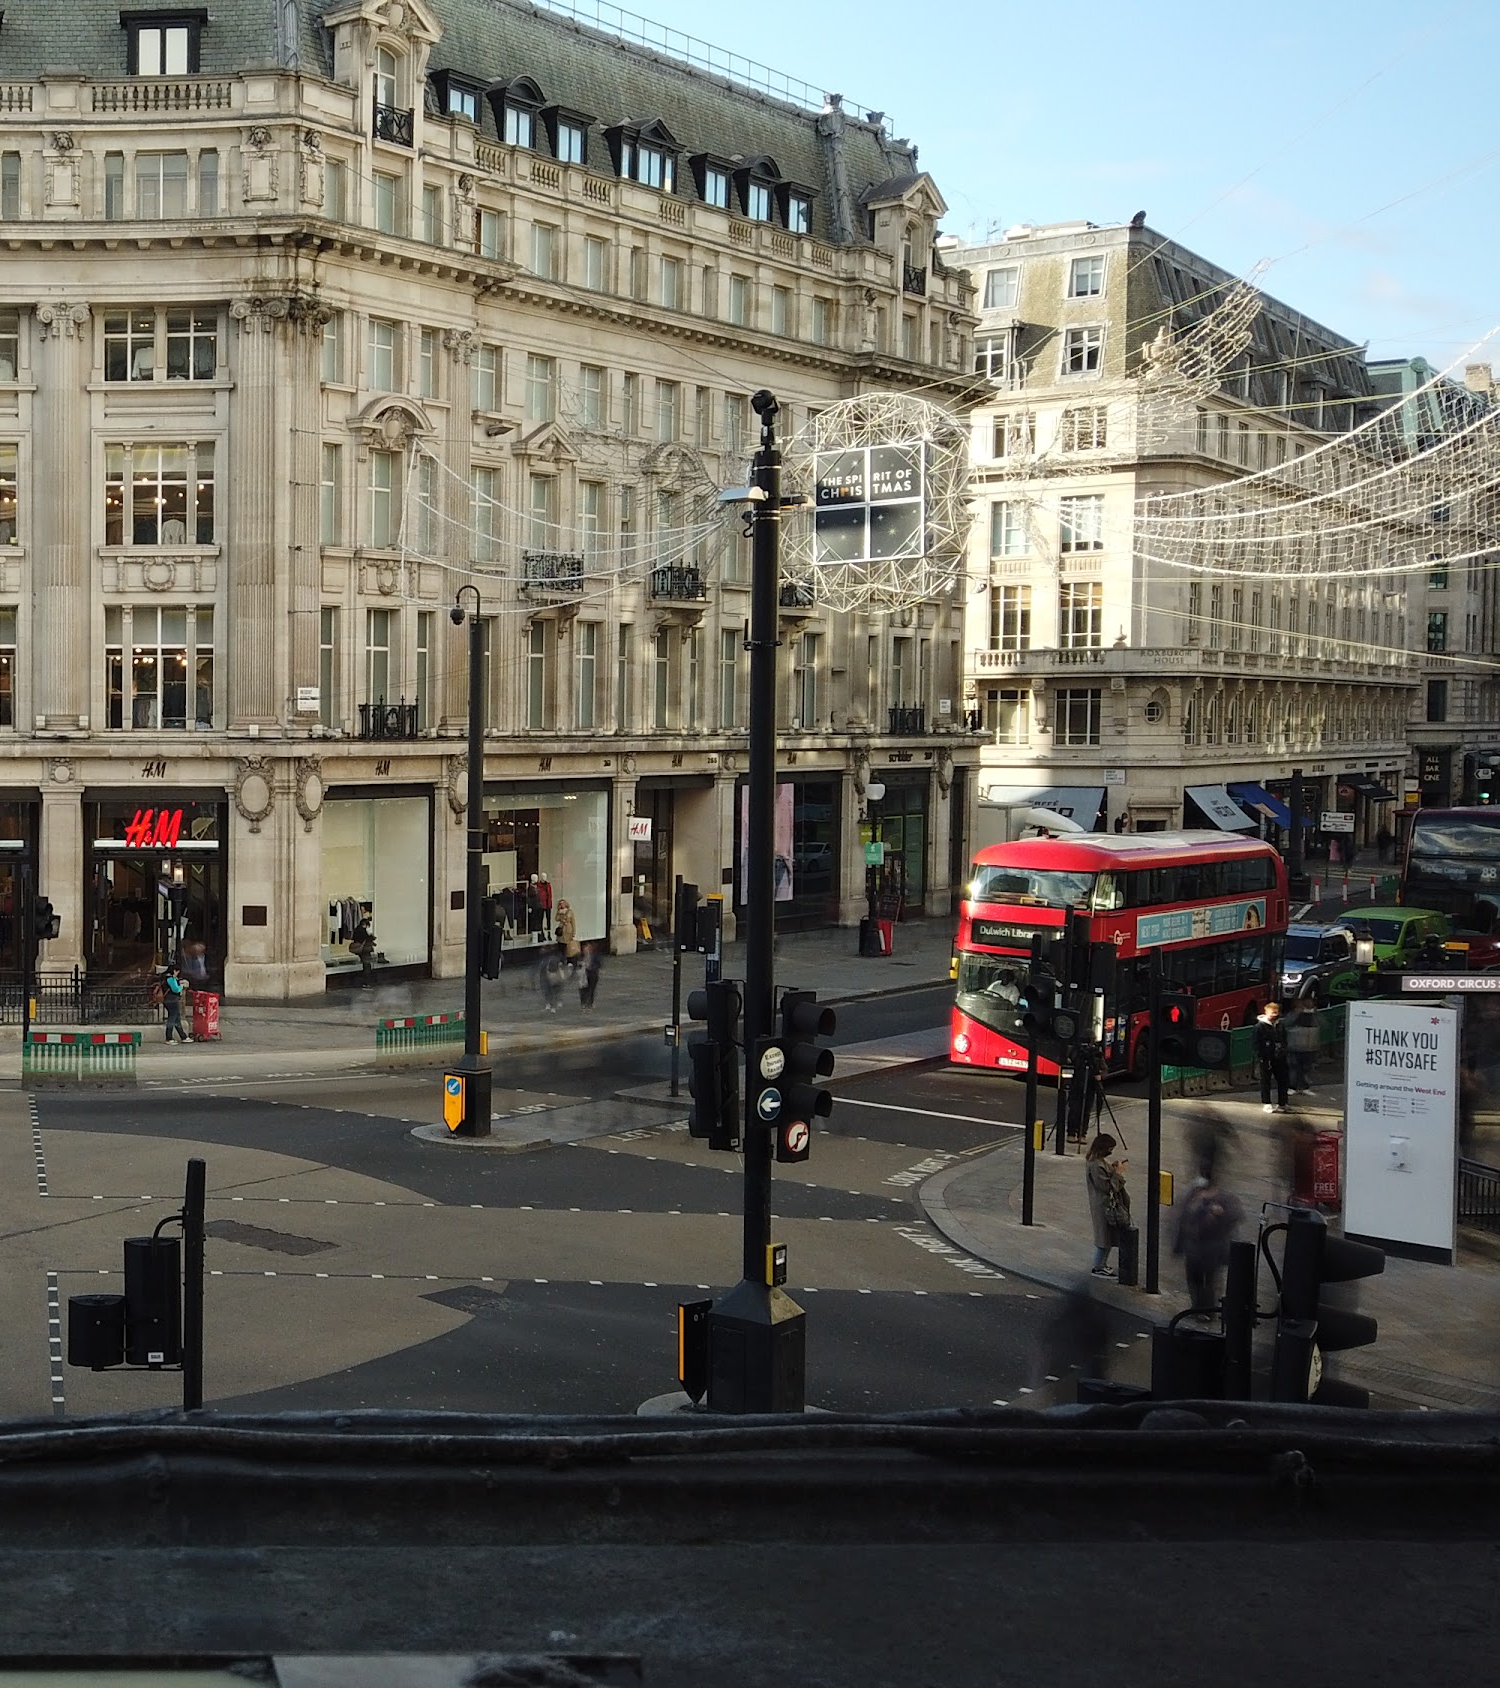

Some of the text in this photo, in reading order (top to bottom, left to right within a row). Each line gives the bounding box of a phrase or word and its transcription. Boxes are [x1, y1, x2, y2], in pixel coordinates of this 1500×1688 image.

[822, 477, 842, 486] THE
[895, 469, 912, 479] OF
[141, 761, 167, 778] H&M
[375, 759, 390, 776] H&M
[538, 757, 552, 772] H&M
[124, 809, 183, 848] H&M
[630, 823, 648, 836] H&M
[1481, 867, 1497, 878] 88
[980, 925, 1036, 939] Dulwich Librar
[1409, 979, 1496, 989] OXFORD CIRCUS
[1365, 1028, 1438, 1050] THANK YOU
[765, 1051, 781, 1060] Except
[1365, 1049, 1437, 1071] #STAYSAFE
[1355, 1080, 1379, 1090] Getting
[1379, 1084, 1402, 1092] around
[1414, 1086, 1432, 1095] West
[1432, 1088, 1446, 1096] End
[1314, 1182, 1335, 1191] FREE
[944, 1257, 1005, 1279] LOOK
